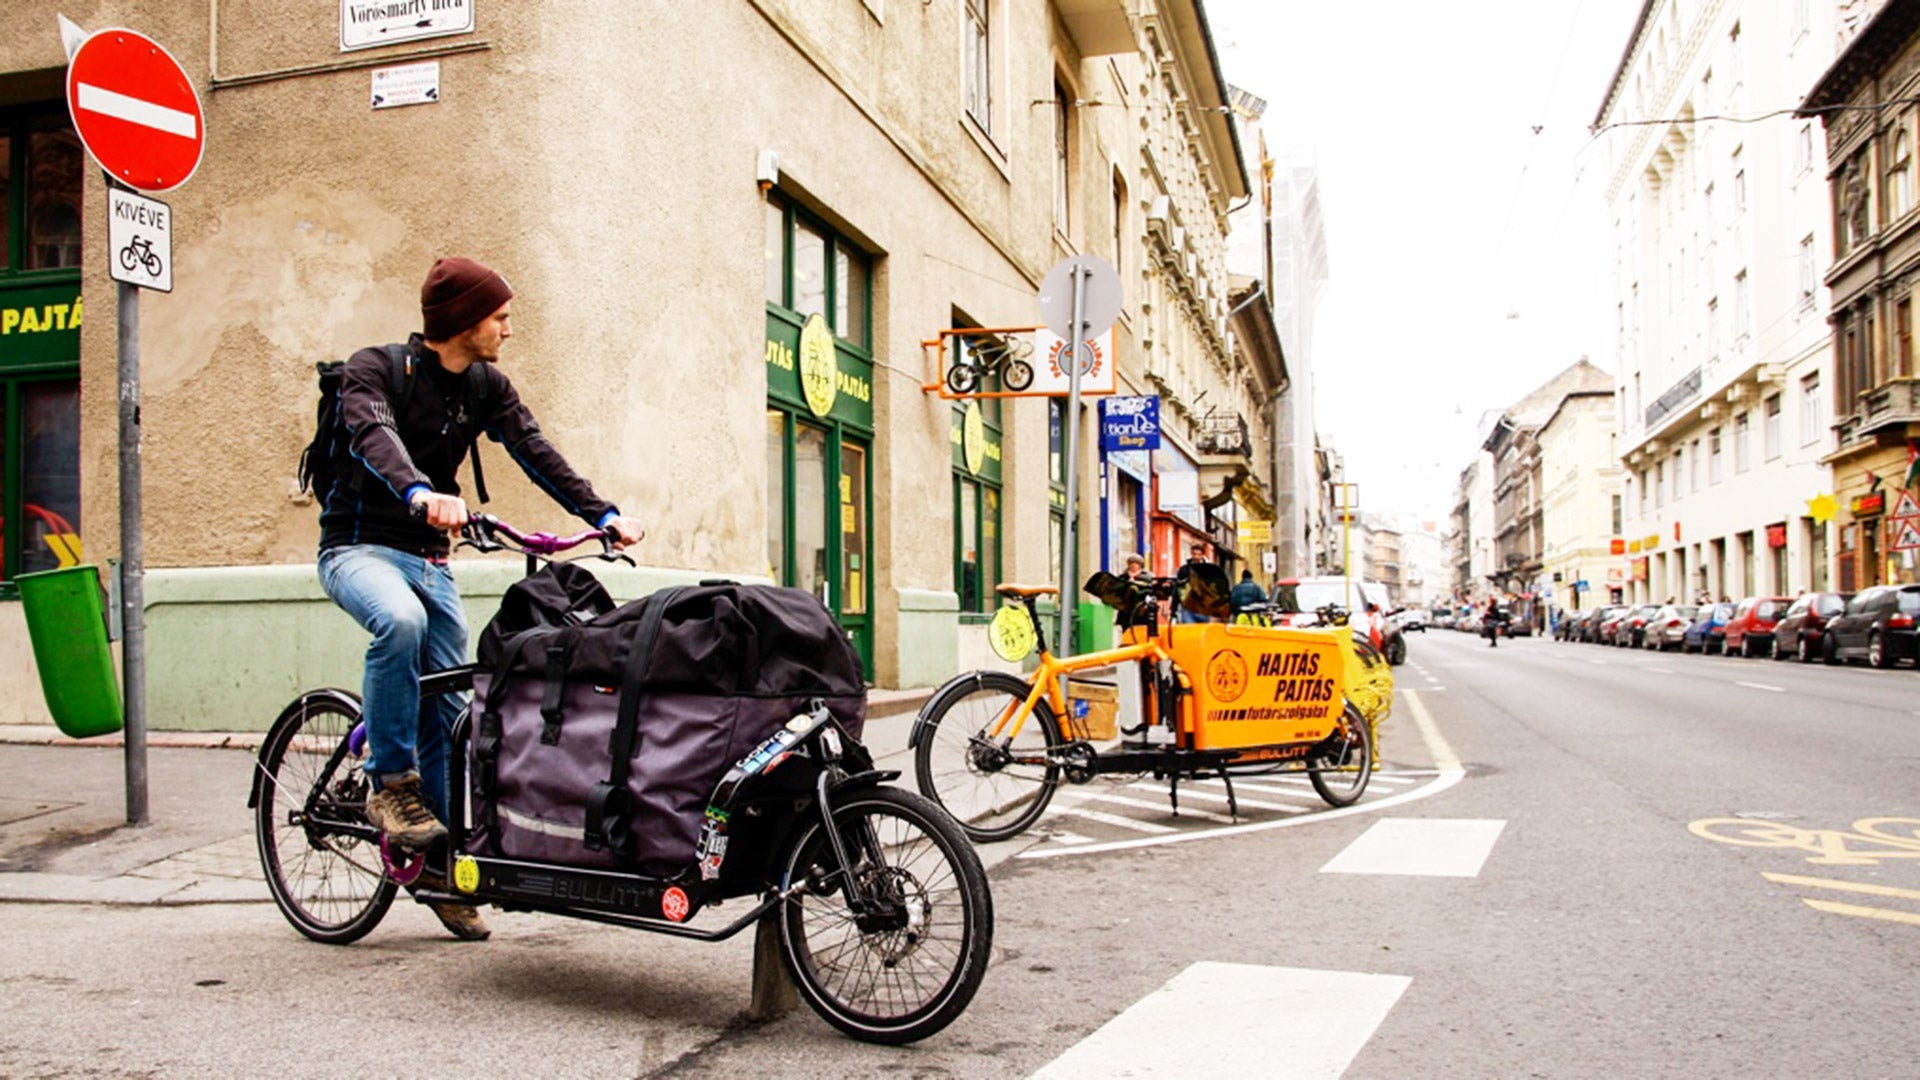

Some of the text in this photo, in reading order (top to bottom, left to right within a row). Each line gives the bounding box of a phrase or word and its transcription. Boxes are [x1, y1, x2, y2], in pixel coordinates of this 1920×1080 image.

[115, 200, 164, 231] KIVÉVE
[2, 296, 82, 334] PAJTÁ
[766, 340, 870, 403] JTÁS PAJTÁS
[1119, 435, 1145, 447] Shop
[1257, 649, 1320, 676] HAJTÁS
[1274, 675, 1334, 702] PAJTÁS
[1247, 705, 1329, 721] futárszolgálat
